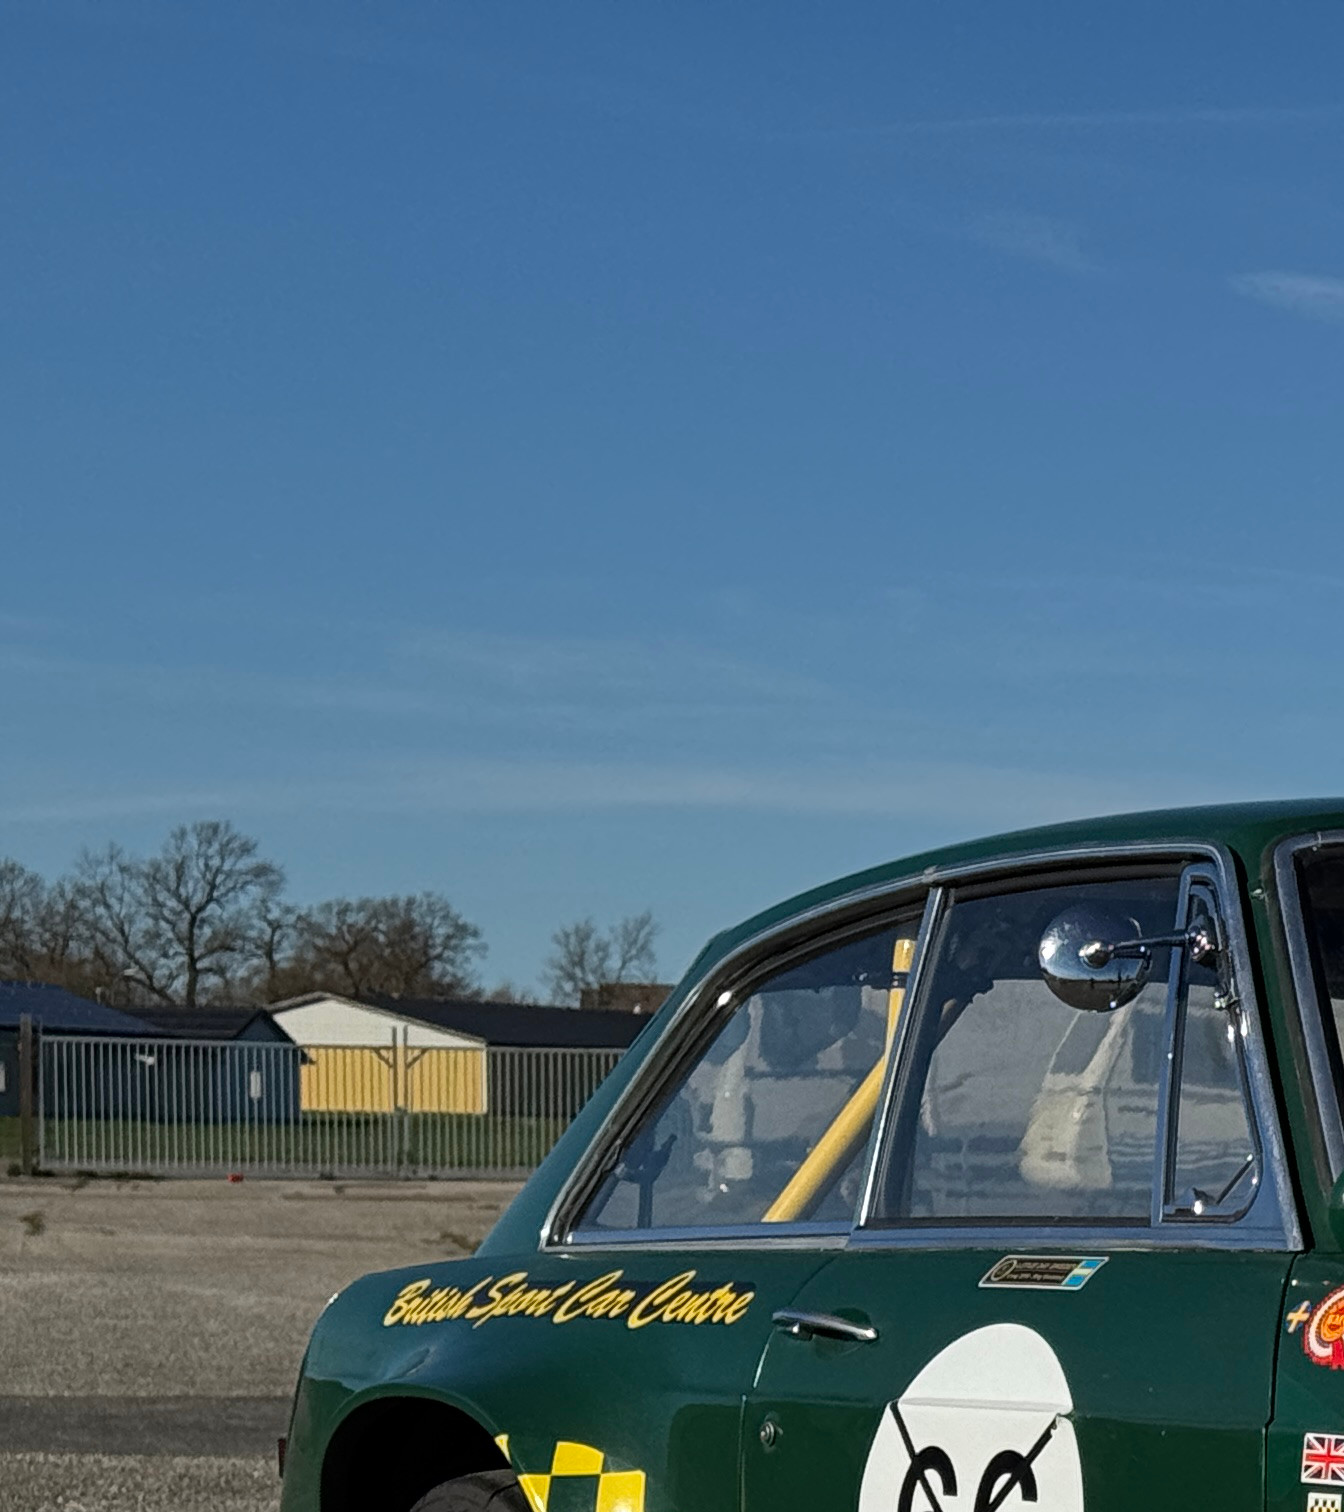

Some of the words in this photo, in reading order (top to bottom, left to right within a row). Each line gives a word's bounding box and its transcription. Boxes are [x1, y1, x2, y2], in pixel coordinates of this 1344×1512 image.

[384, 1278, 493, 1326] British
[467, 1272, 577, 1329] Sport
[553, 1270, 636, 1324] Car
[627, 1270, 754, 1329] Centre
